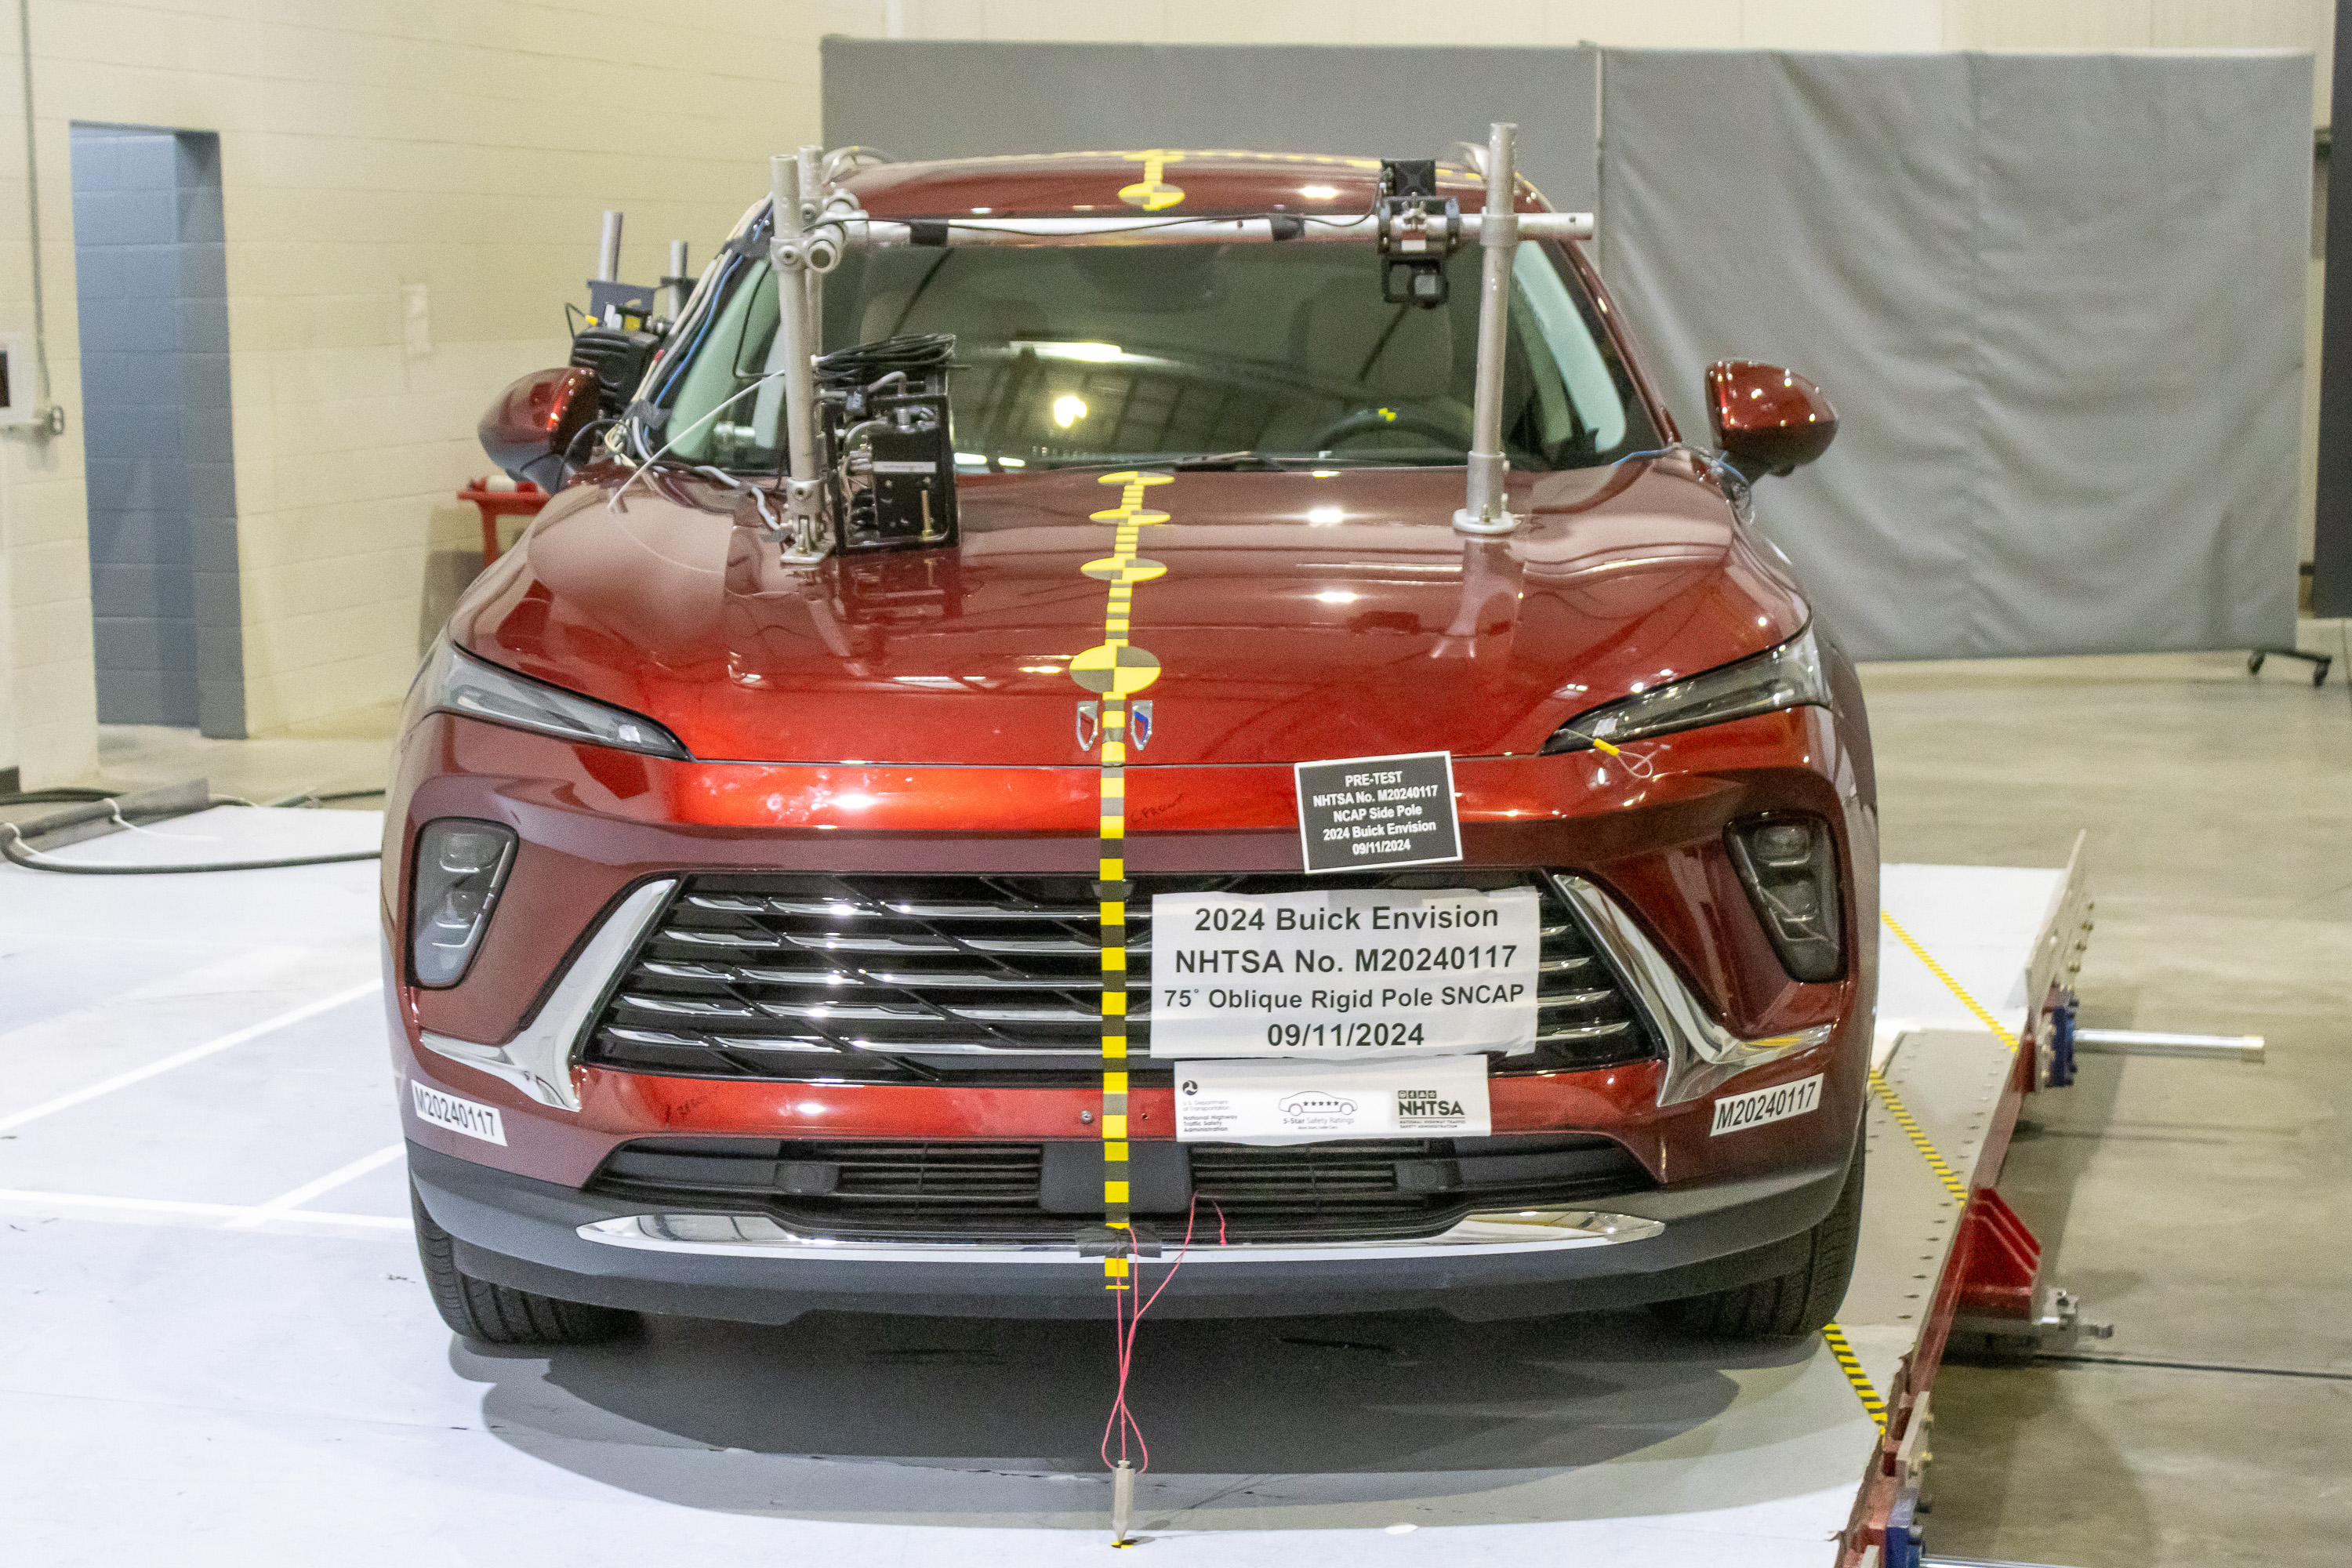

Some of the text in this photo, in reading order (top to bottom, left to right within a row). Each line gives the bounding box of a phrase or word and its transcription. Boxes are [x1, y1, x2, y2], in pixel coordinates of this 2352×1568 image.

[1345, 771, 1403, 787] PRE-TEST
[1312, 785, 1439, 808] NHTSA No. M20240117
[1333, 804, 1422, 822] NCAP Side Pole
[1323, 821, 1436, 841] 2024 Buick Envision
[1352, 838, 1411, 856] 09/11/2024
[1194, 904, 1499, 931] 2024 Buick Envision
[1175, 944, 1518, 975] NHTSA No. M20240117
[1208, 989, 1302, 1013] Oblique
[1311, 988, 1374, 1014] Rigid
[1381, 986, 1433, 1008] Pole
[1441, 983, 1525, 1006] SNCAP
[1267, 1022, 1425, 1047] 09/11/2024
[414, 1085, 495, 1137] M20240117
[1399, 1101, 1465, 1116] NHTSA
[1716, 1080, 1817, 1130] M20240117
